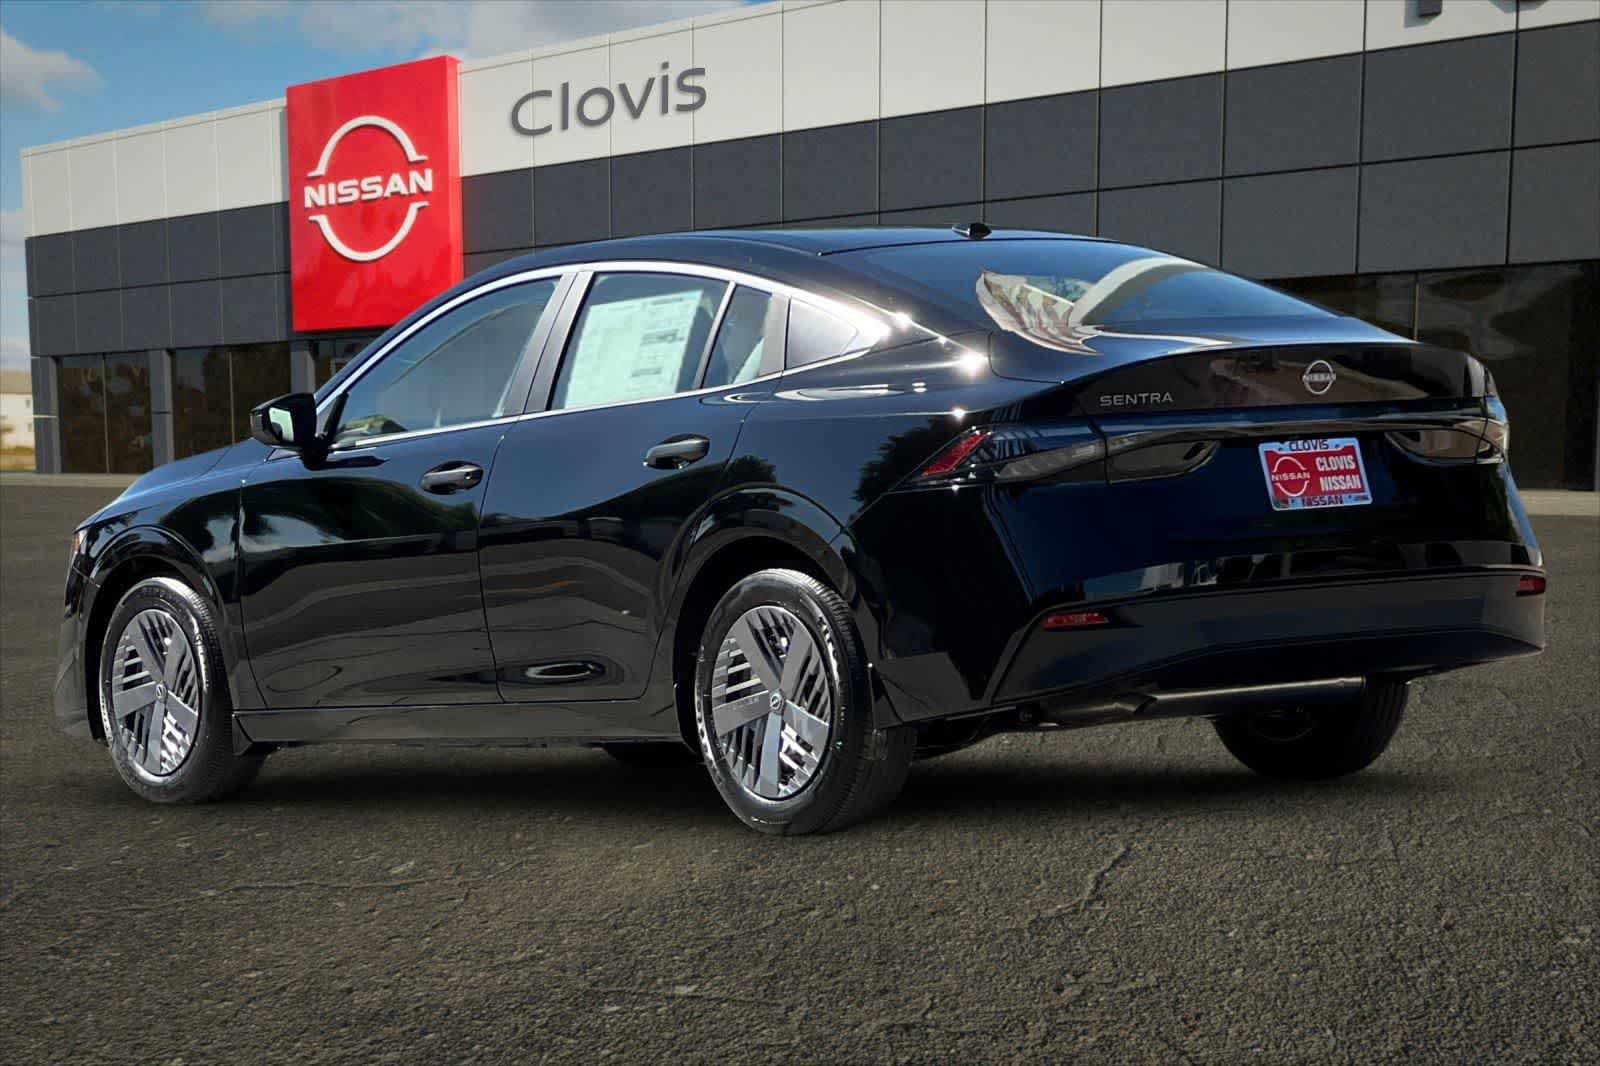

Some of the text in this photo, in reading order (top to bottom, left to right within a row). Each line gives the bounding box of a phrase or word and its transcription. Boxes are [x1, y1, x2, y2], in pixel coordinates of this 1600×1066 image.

[511, 61, 707, 136] Clovis
[304, 168, 433, 209] NISSAN
[1100, 392, 1174, 407] SENTRA
[1289, 439, 1329, 451] CLOVIS
[1315, 454, 1356, 472] CLOVIS
[1271, 471, 1311, 481] NISSAN
[1319, 474, 1361, 491] NISSAN
[1302, 495, 1344, 506] NISSAN
